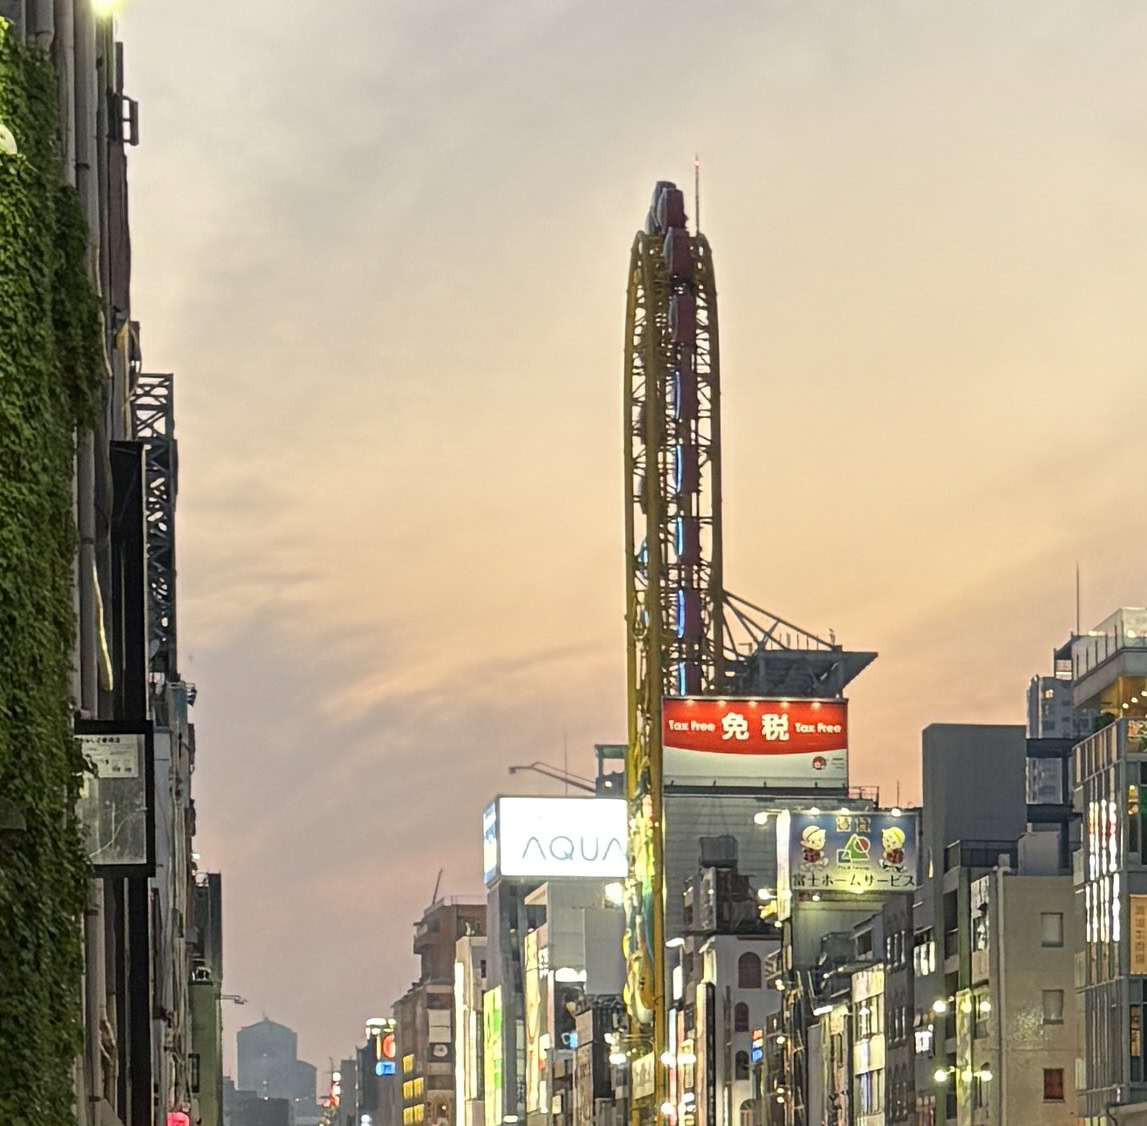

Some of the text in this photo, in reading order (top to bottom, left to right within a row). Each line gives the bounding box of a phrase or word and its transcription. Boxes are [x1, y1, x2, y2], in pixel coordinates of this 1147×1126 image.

[669, 720, 716, 732] Tax Free
[795, 723, 842, 733] Tax Free
[522, 836, 628, 861] AQUA
[793, 873, 915, 888] 富士ホームサービス
